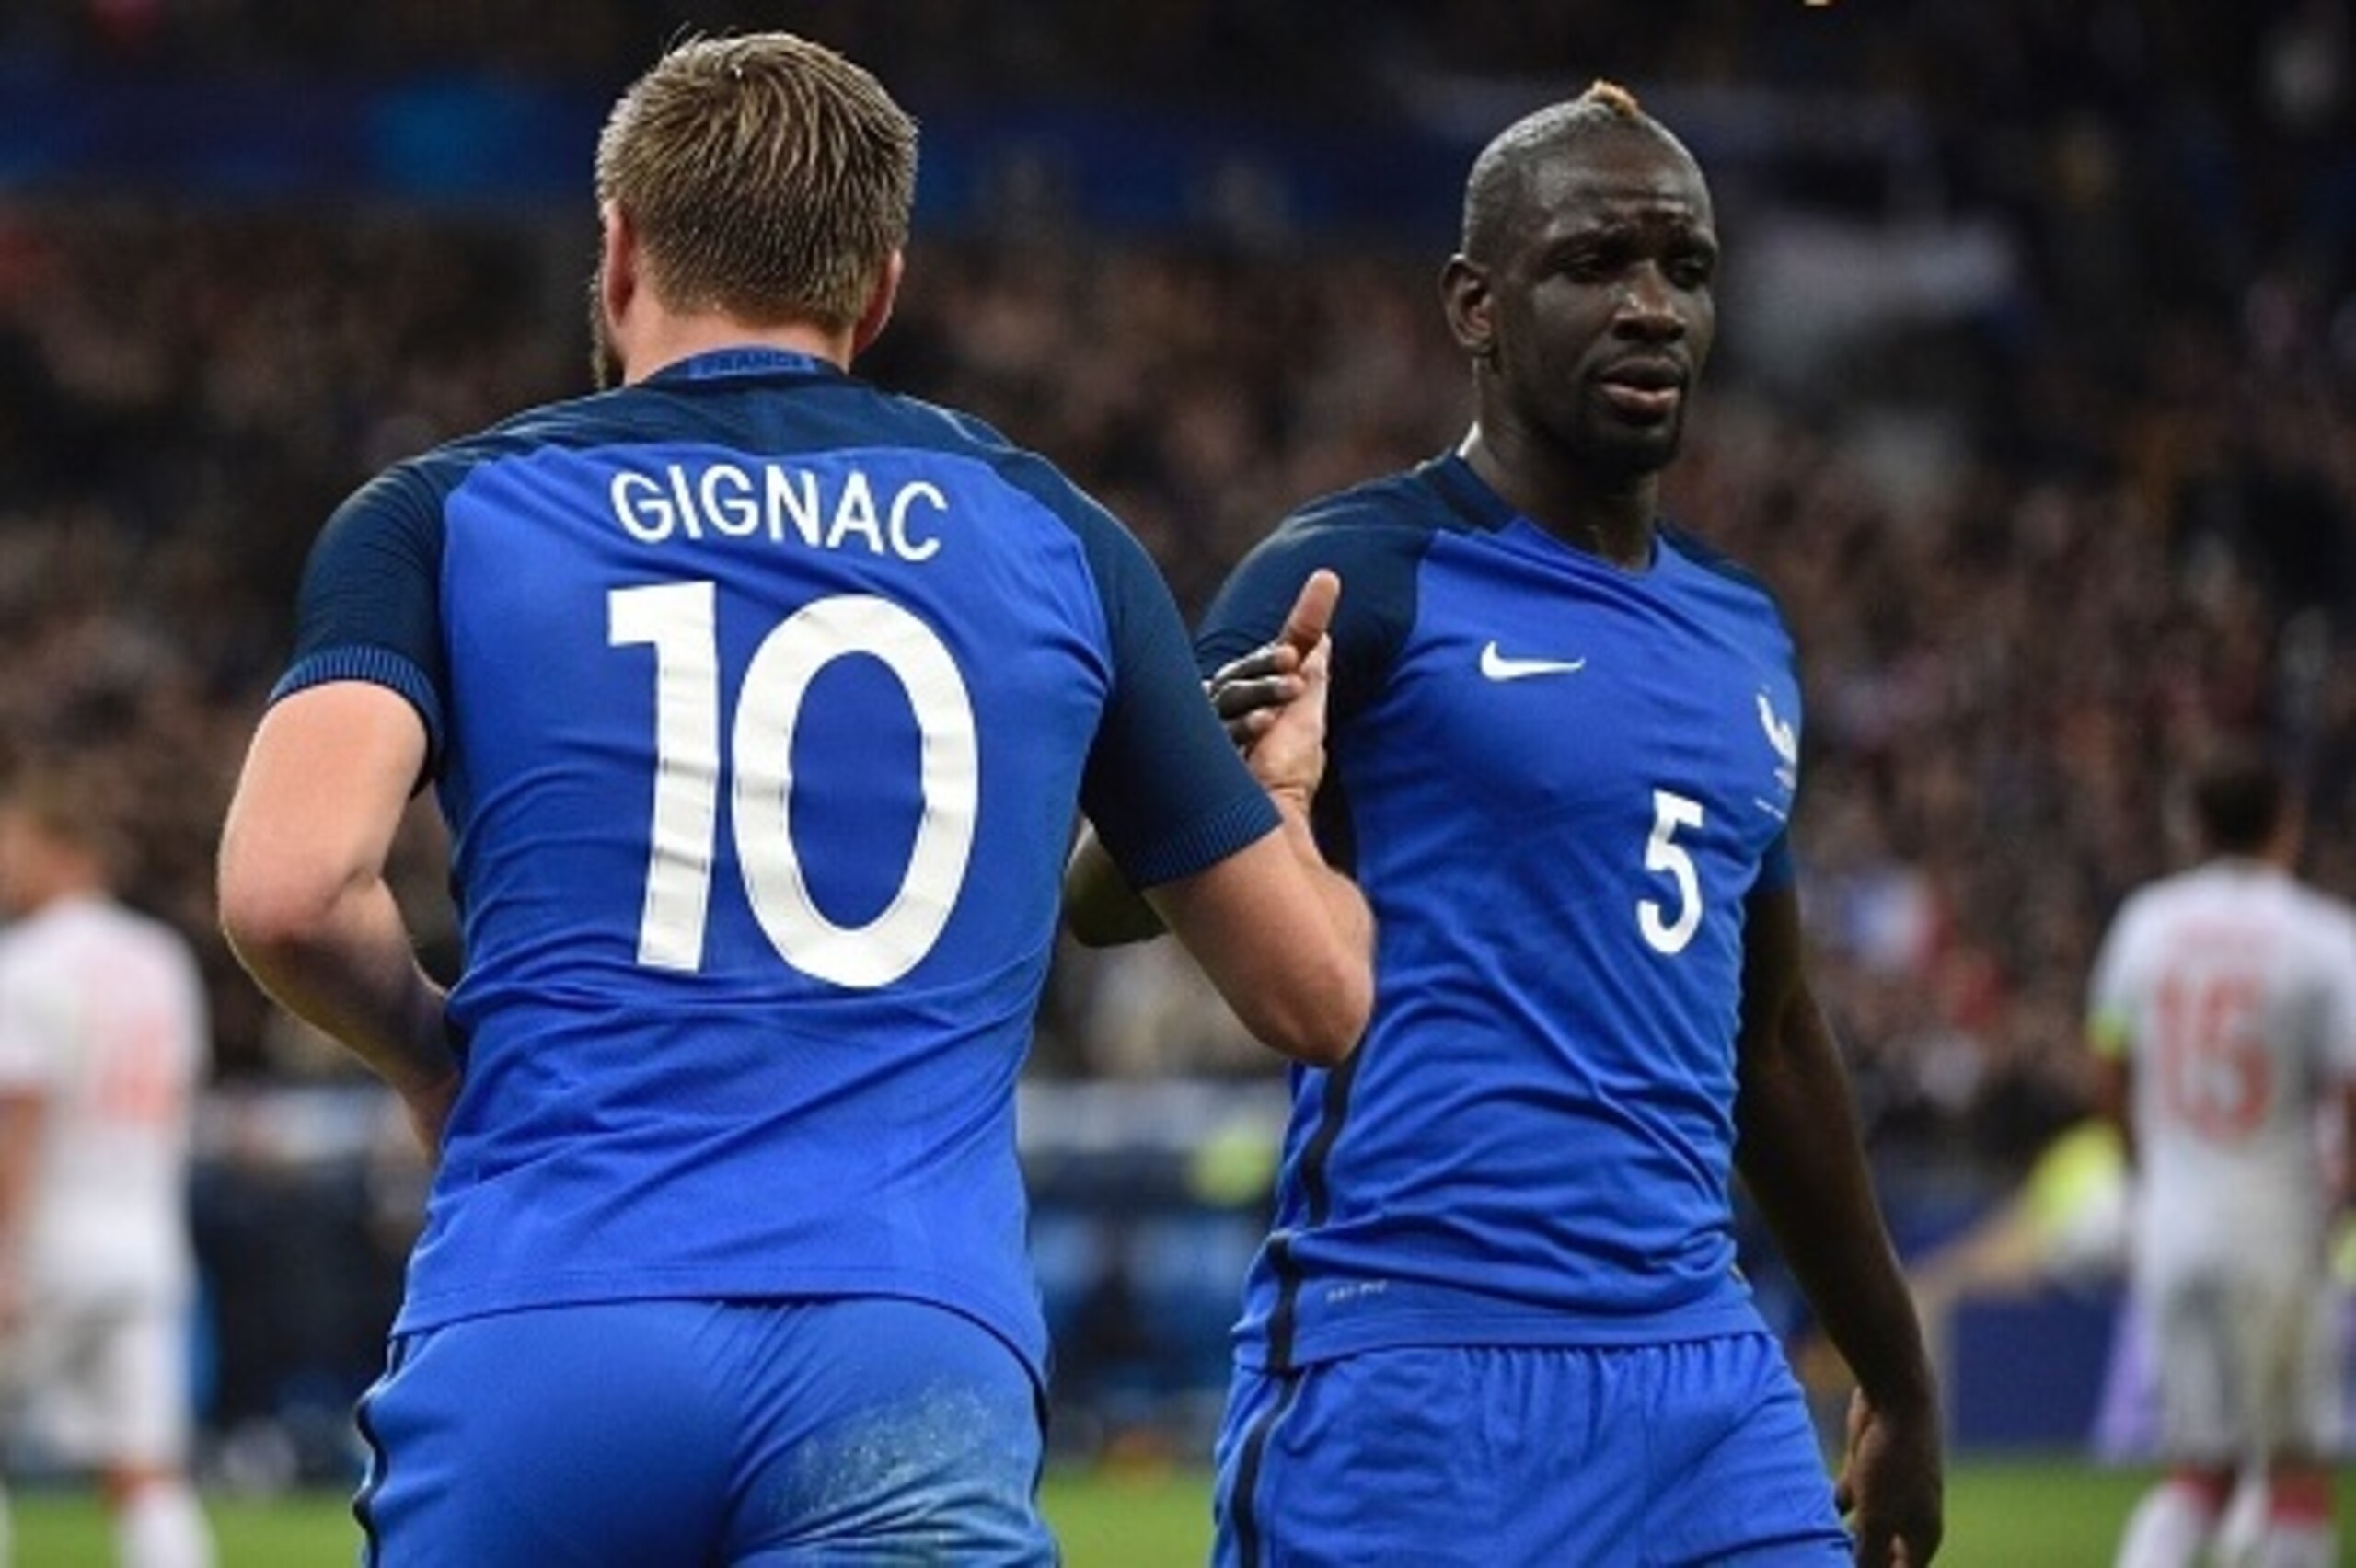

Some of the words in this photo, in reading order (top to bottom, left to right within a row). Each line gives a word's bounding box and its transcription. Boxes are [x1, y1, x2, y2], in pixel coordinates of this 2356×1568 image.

[610, 463, 948, 562] GIGNAC
[607, 580, 978, 988] 10
[1636, 789, 1703, 954] 5
